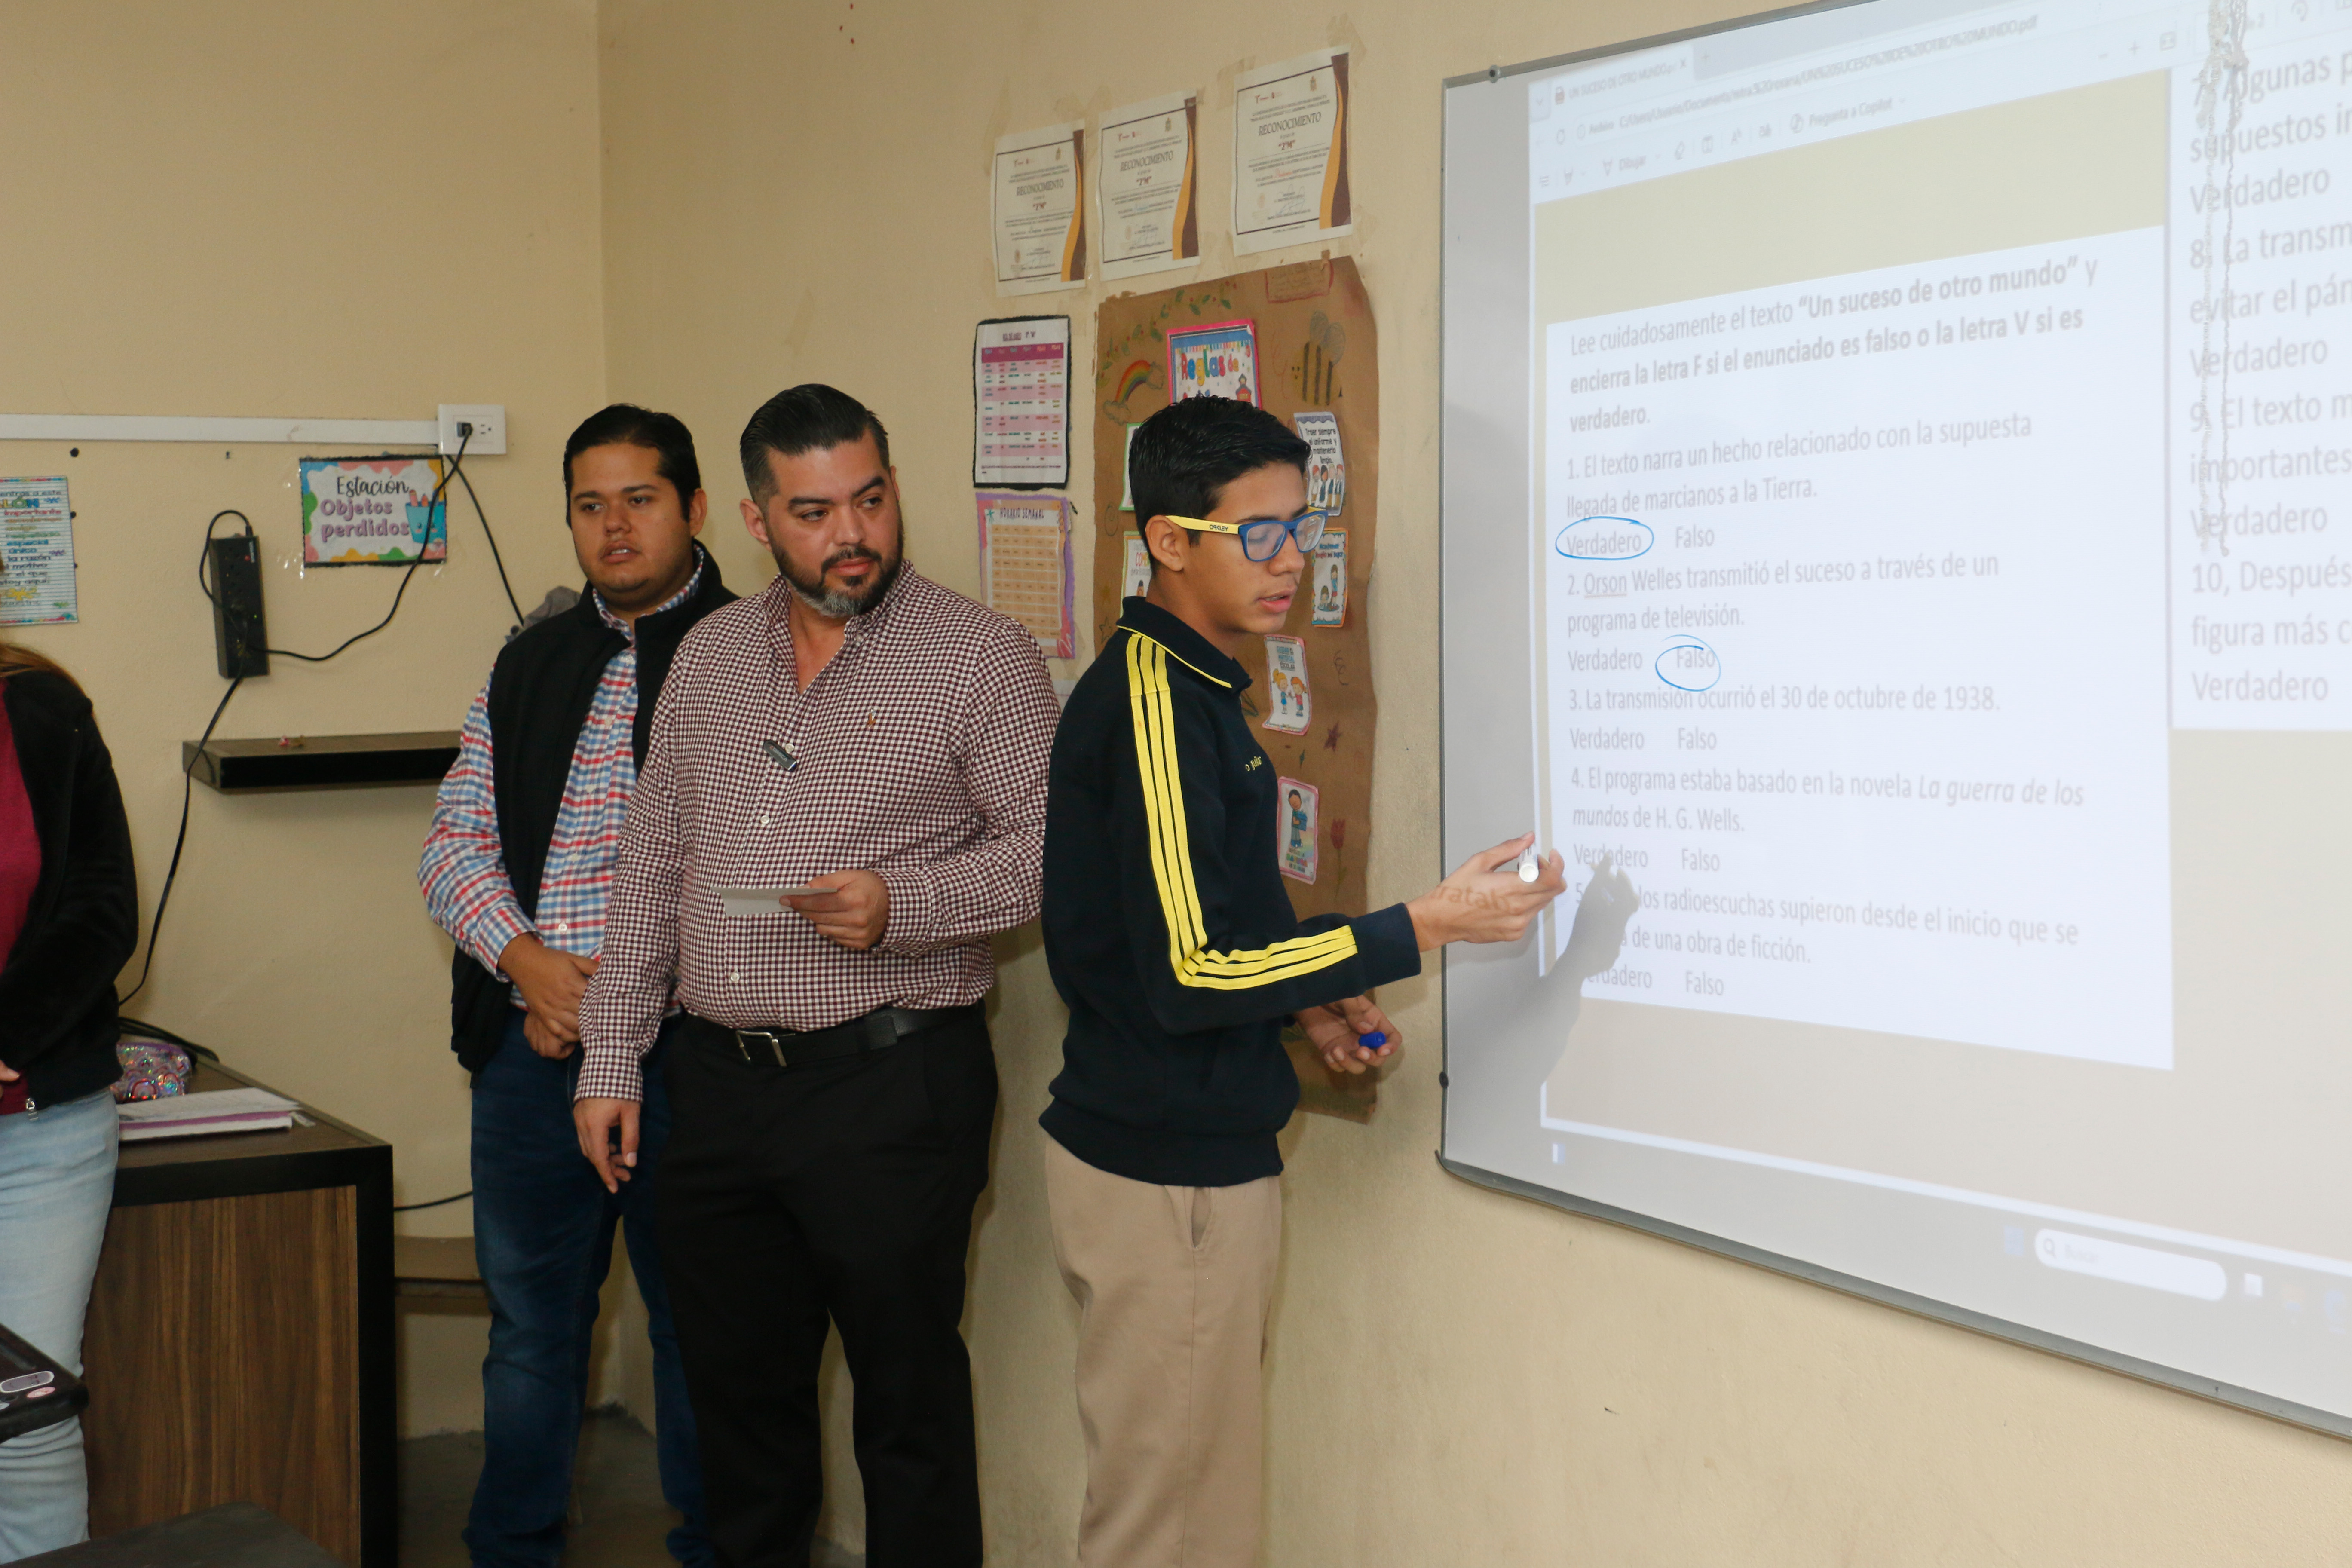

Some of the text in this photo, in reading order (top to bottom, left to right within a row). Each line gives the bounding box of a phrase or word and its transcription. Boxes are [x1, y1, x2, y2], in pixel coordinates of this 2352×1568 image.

[1259, 112, 1321, 136] RECONOCIMIENTO
[1619, 154, 1647, 171] Dibujar
[1809, 107, 1848, 127] Pregunta
[1859, 97, 1892, 117] Copilot
[2190, 113, 2327, 165] supuestos
[1120, 150, 1173, 172] RECONOCIMIENTO
[1016, 178, 1064, 196] RECONOCIMIENTO
[2190, 167, 2330, 214] Verdadero
[2223, 235, 2249, 266] La
[1571, 334, 1596, 355] Lee
[1599, 312, 1725, 351] cuidadosamente
[1731, 306, 1745, 330] el
[1750, 302, 1793, 328] texto
[1838, 286, 1902, 315] suceso
[1908, 278, 1932, 304] de
[1939, 275, 1982, 300] otro
[2085, 258, 2098, 287] y
[2190, 289, 2264, 324] evitar
[2273, 277, 2296, 313] el
[1181, 349, 1239, 386] Reglas de
[1571, 306, 2083, 394] encierra la letra F si el enunciado es falso o la letra V si es
[2190, 335, 2328, 377] Verdadero
[1570, 405, 1651, 433] verdadero.
[2221, 392, 2322, 429] El texto
[1567, 412, 2032, 479] 1. El texto narra un hecho relacionado con la supuesta
[2190, 445, 2352, 490] importantes
[337, 475, 409, 498] Estación
[1567, 476, 1817, 522] llegada de marcianos a la Tierra.
[320, 497, 392, 521] Objetos
[2190, 502, 2328, 538] Verdadero
[321, 518, 410, 543] perdidos
[1567, 524, 1715, 556] Verdadero Falso
[1568, 551, 2000, 597] 2. Orson Welles transmitió el suceso a través de un
[2240, 554, 2352, 597] Después
[1568, 603, 1744, 636] programa de televisión.
[2192, 611, 2328, 655] figura más
[1568, 646, 1716, 671] Verdadero Falso
[1569, 684, 2001, 711] 3. La transmisión ocurrió el 30 de octubre de 1938.
[2192, 669, 2328, 701] Verdadero
[1570, 726, 1717, 750] Verdadero Falso
[1571, 766, 2084, 807] 4. El programa estaba basado en la novela La guerra de los
[1573, 804, 1745, 832] mundos de H. G. Wells.
[1681, 847, 1720, 873] Falso
[1639, 884, 2079, 946] los radioescuchas supieron desde el inicio que se
[1632, 925, 1811, 963] de una obra de ficción.
[1586, 964, 1724, 996] erdadero Falso
